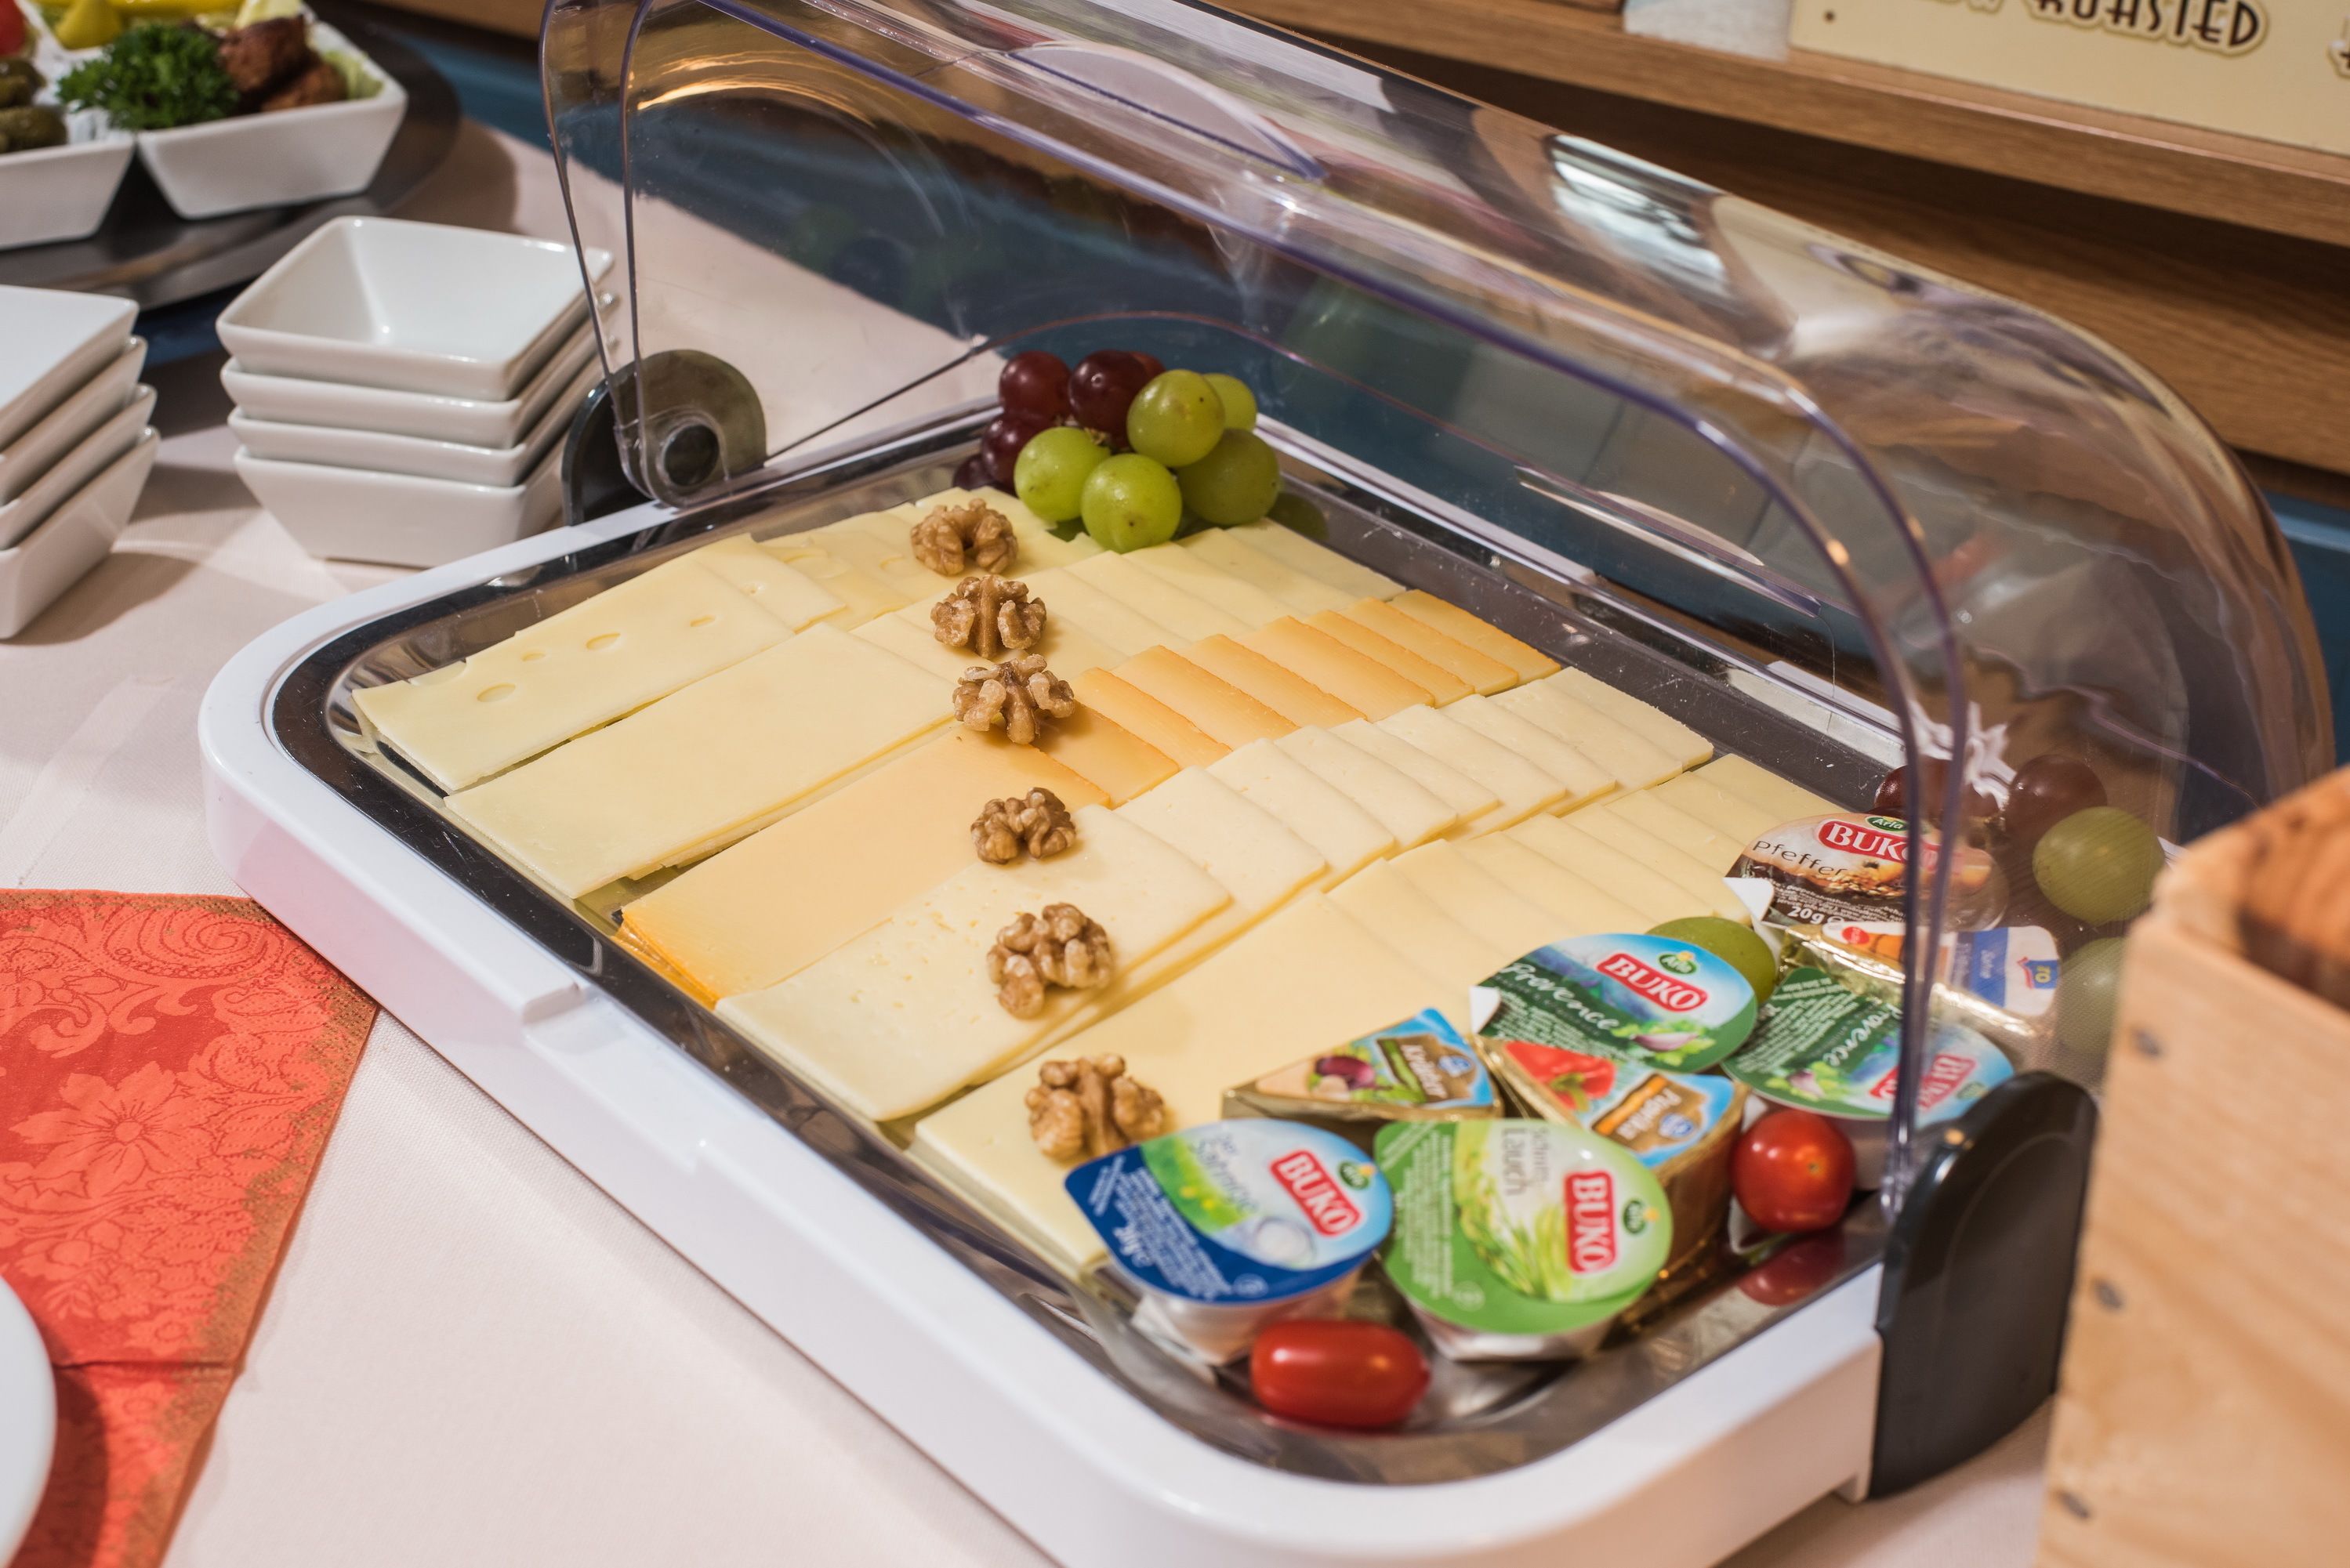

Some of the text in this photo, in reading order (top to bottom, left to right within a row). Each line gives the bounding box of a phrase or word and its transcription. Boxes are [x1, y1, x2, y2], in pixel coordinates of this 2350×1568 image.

[2038, 0, 2261, 47] ASTED
[1872, 818, 1903, 829] Arla
[1787, 906, 1825, 925] 20g
[1606, 957, 1702, 1010] BUKO
[1277, 1155, 1357, 1233] BUKO
[1572, 1177, 1612, 1271] BUKO
